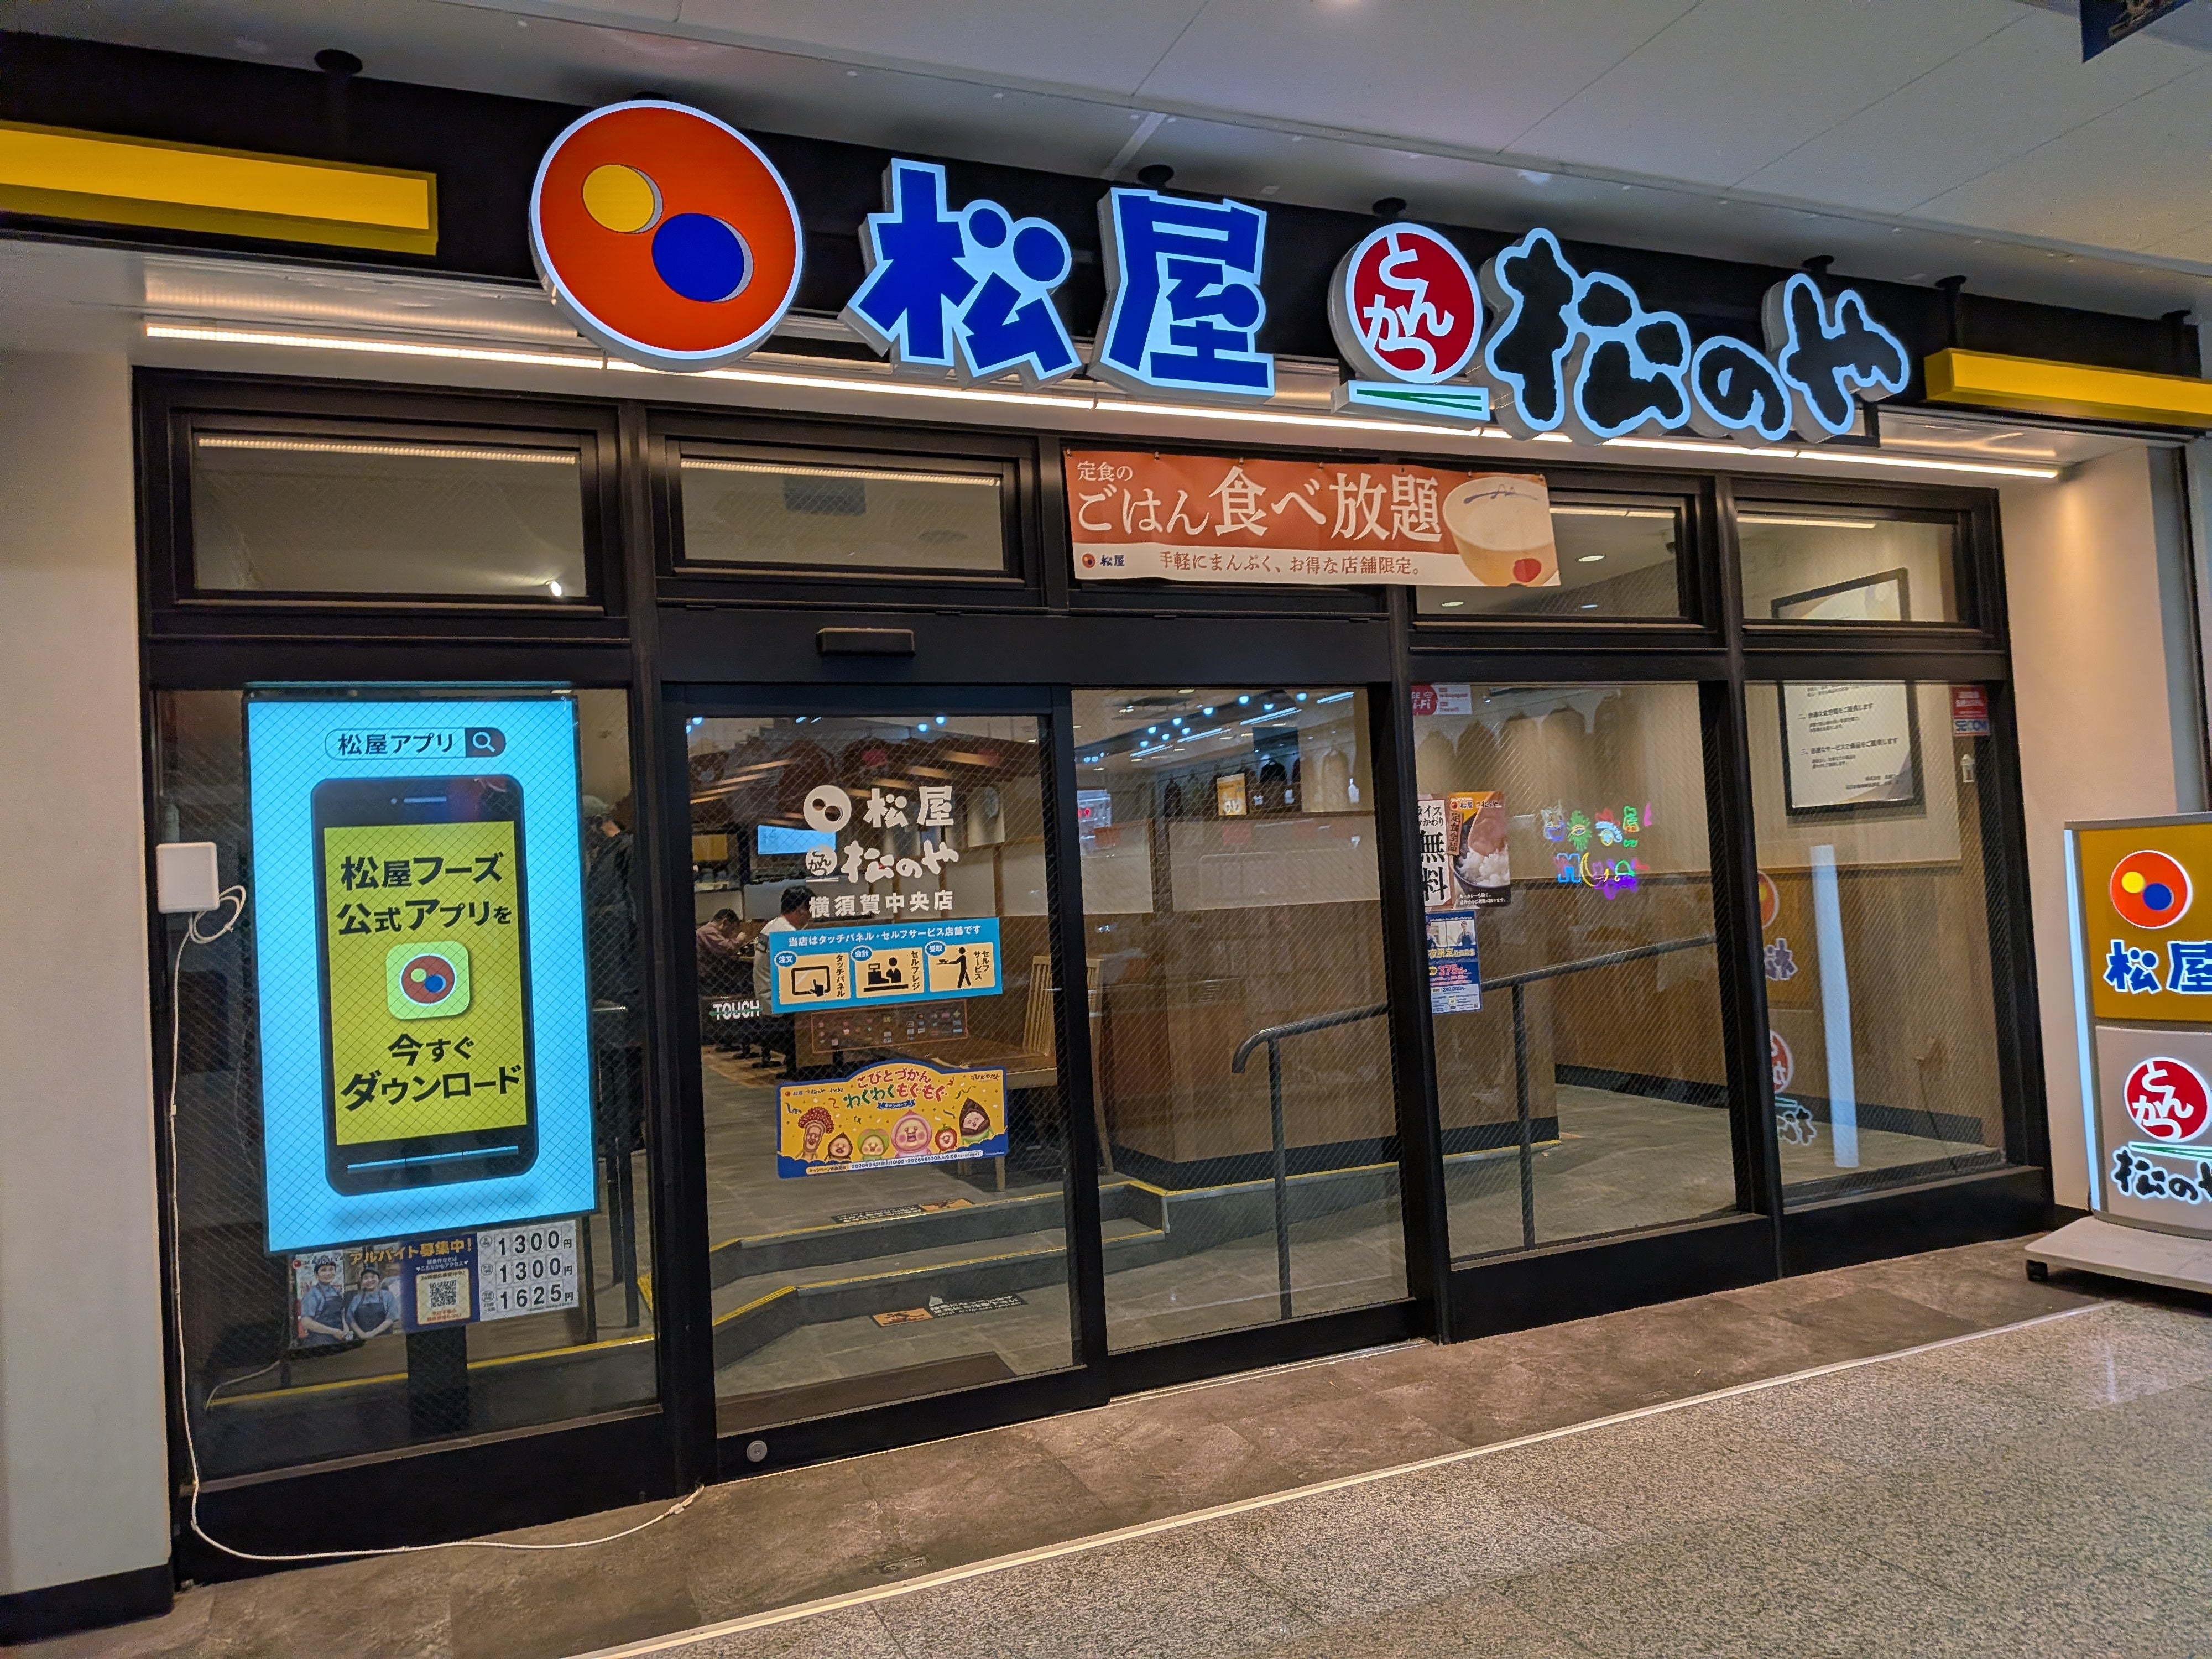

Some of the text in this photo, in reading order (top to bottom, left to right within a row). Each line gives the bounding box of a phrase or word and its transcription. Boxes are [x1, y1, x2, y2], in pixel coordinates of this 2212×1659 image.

[848, 158, 1275, 397] 松屋
[1485, 228, 1911, 441] 松のや
[1077, 461, 1133, 483] 定食の
[1077, 465, 1443, 543] ごはん食べ放題
[1100, 554, 1125, 567] 松屋
[1160, 550, 1419, 575] 手軽にまんぷく、お得な店舗限定。
[337, 733, 453, 755] 松屋アプリ
[863, 785, 954, 828] 松屋
[341, 851, 503, 891] 松屋フーズ
[841, 839, 959, 884] 松のや
[337, 899, 511, 936] 公式アプリを
[808, 889, 953, 919] 横須賀中央店
[789, 925, 982, 947] 当店はタッチパネル・セルフサービス店舗です
[778, 955, 794, 963] 注文
[911, 950, 920, 991] セルフレジ
[973, 950, 982, 980] サービス
[2103, 939, 2212, 994] 松屋
[836, 954, 846, 998] タッチパネル
[713, 1000, 760, 1021] TOUCH
[387, 1034, 474, 1067] 今すぐ
[341, 1064, 521, 1112] ダウンロード
[857, 1067, 932, 1089] こびとづかん
[843, 1082, 948, 1109] わくわくもぐもぐ
